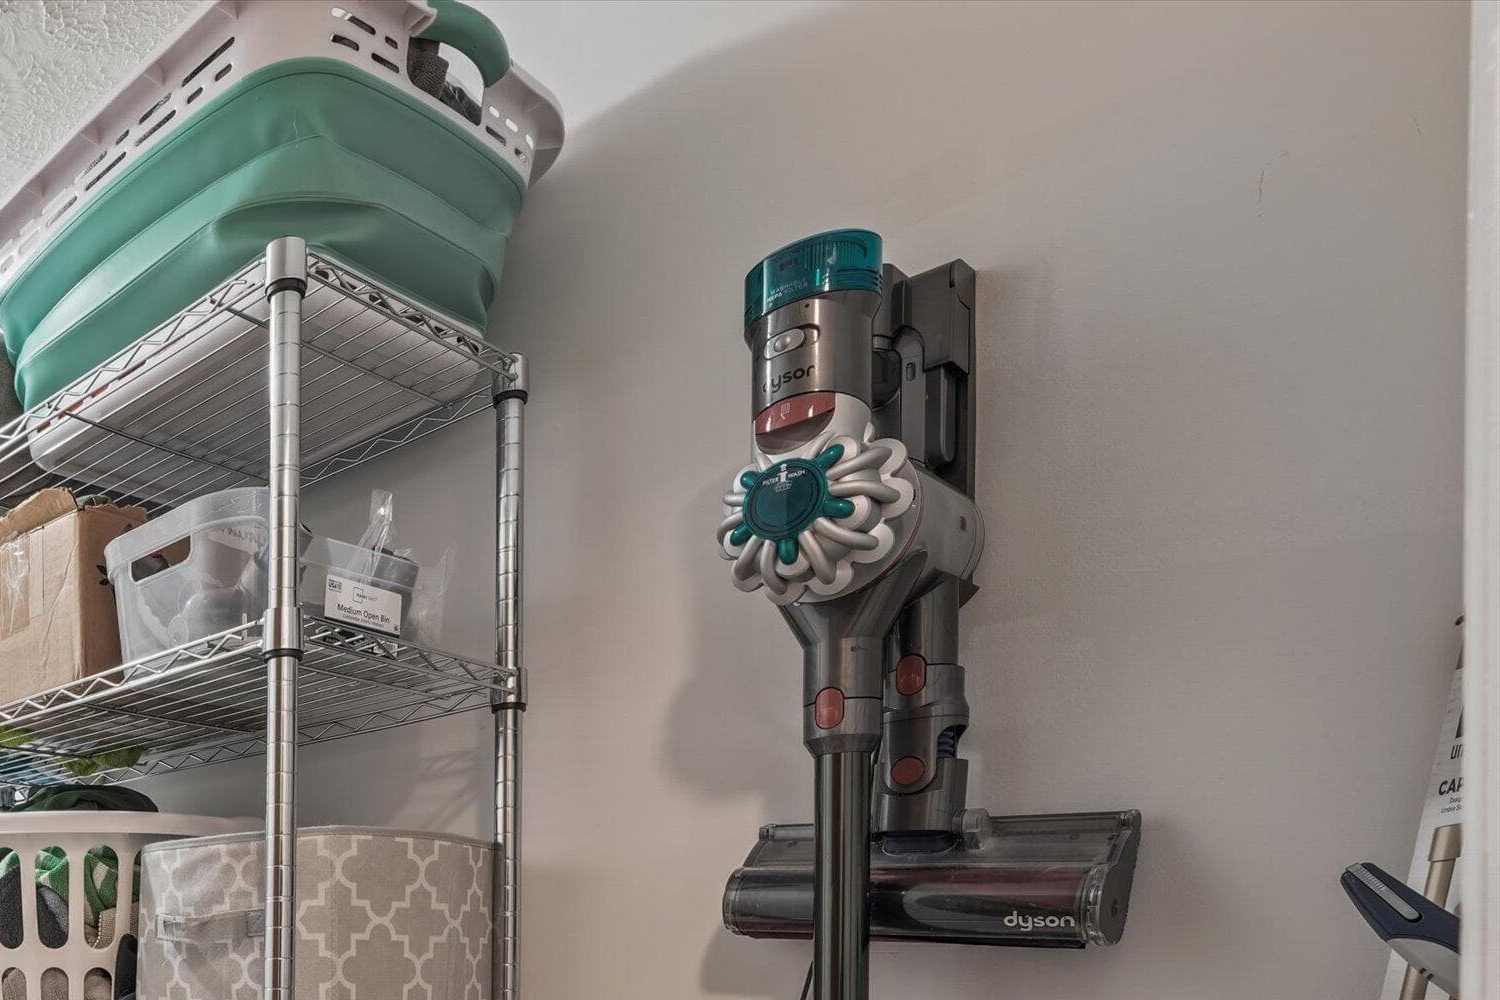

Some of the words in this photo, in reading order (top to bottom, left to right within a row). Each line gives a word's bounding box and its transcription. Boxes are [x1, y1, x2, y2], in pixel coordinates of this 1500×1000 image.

[337, 603, 362, 616] Medium
[363, 610, 380, 621] Open
[380, 614, 390, 623] Bin
[1003, 910, 1076, 931] dyson
